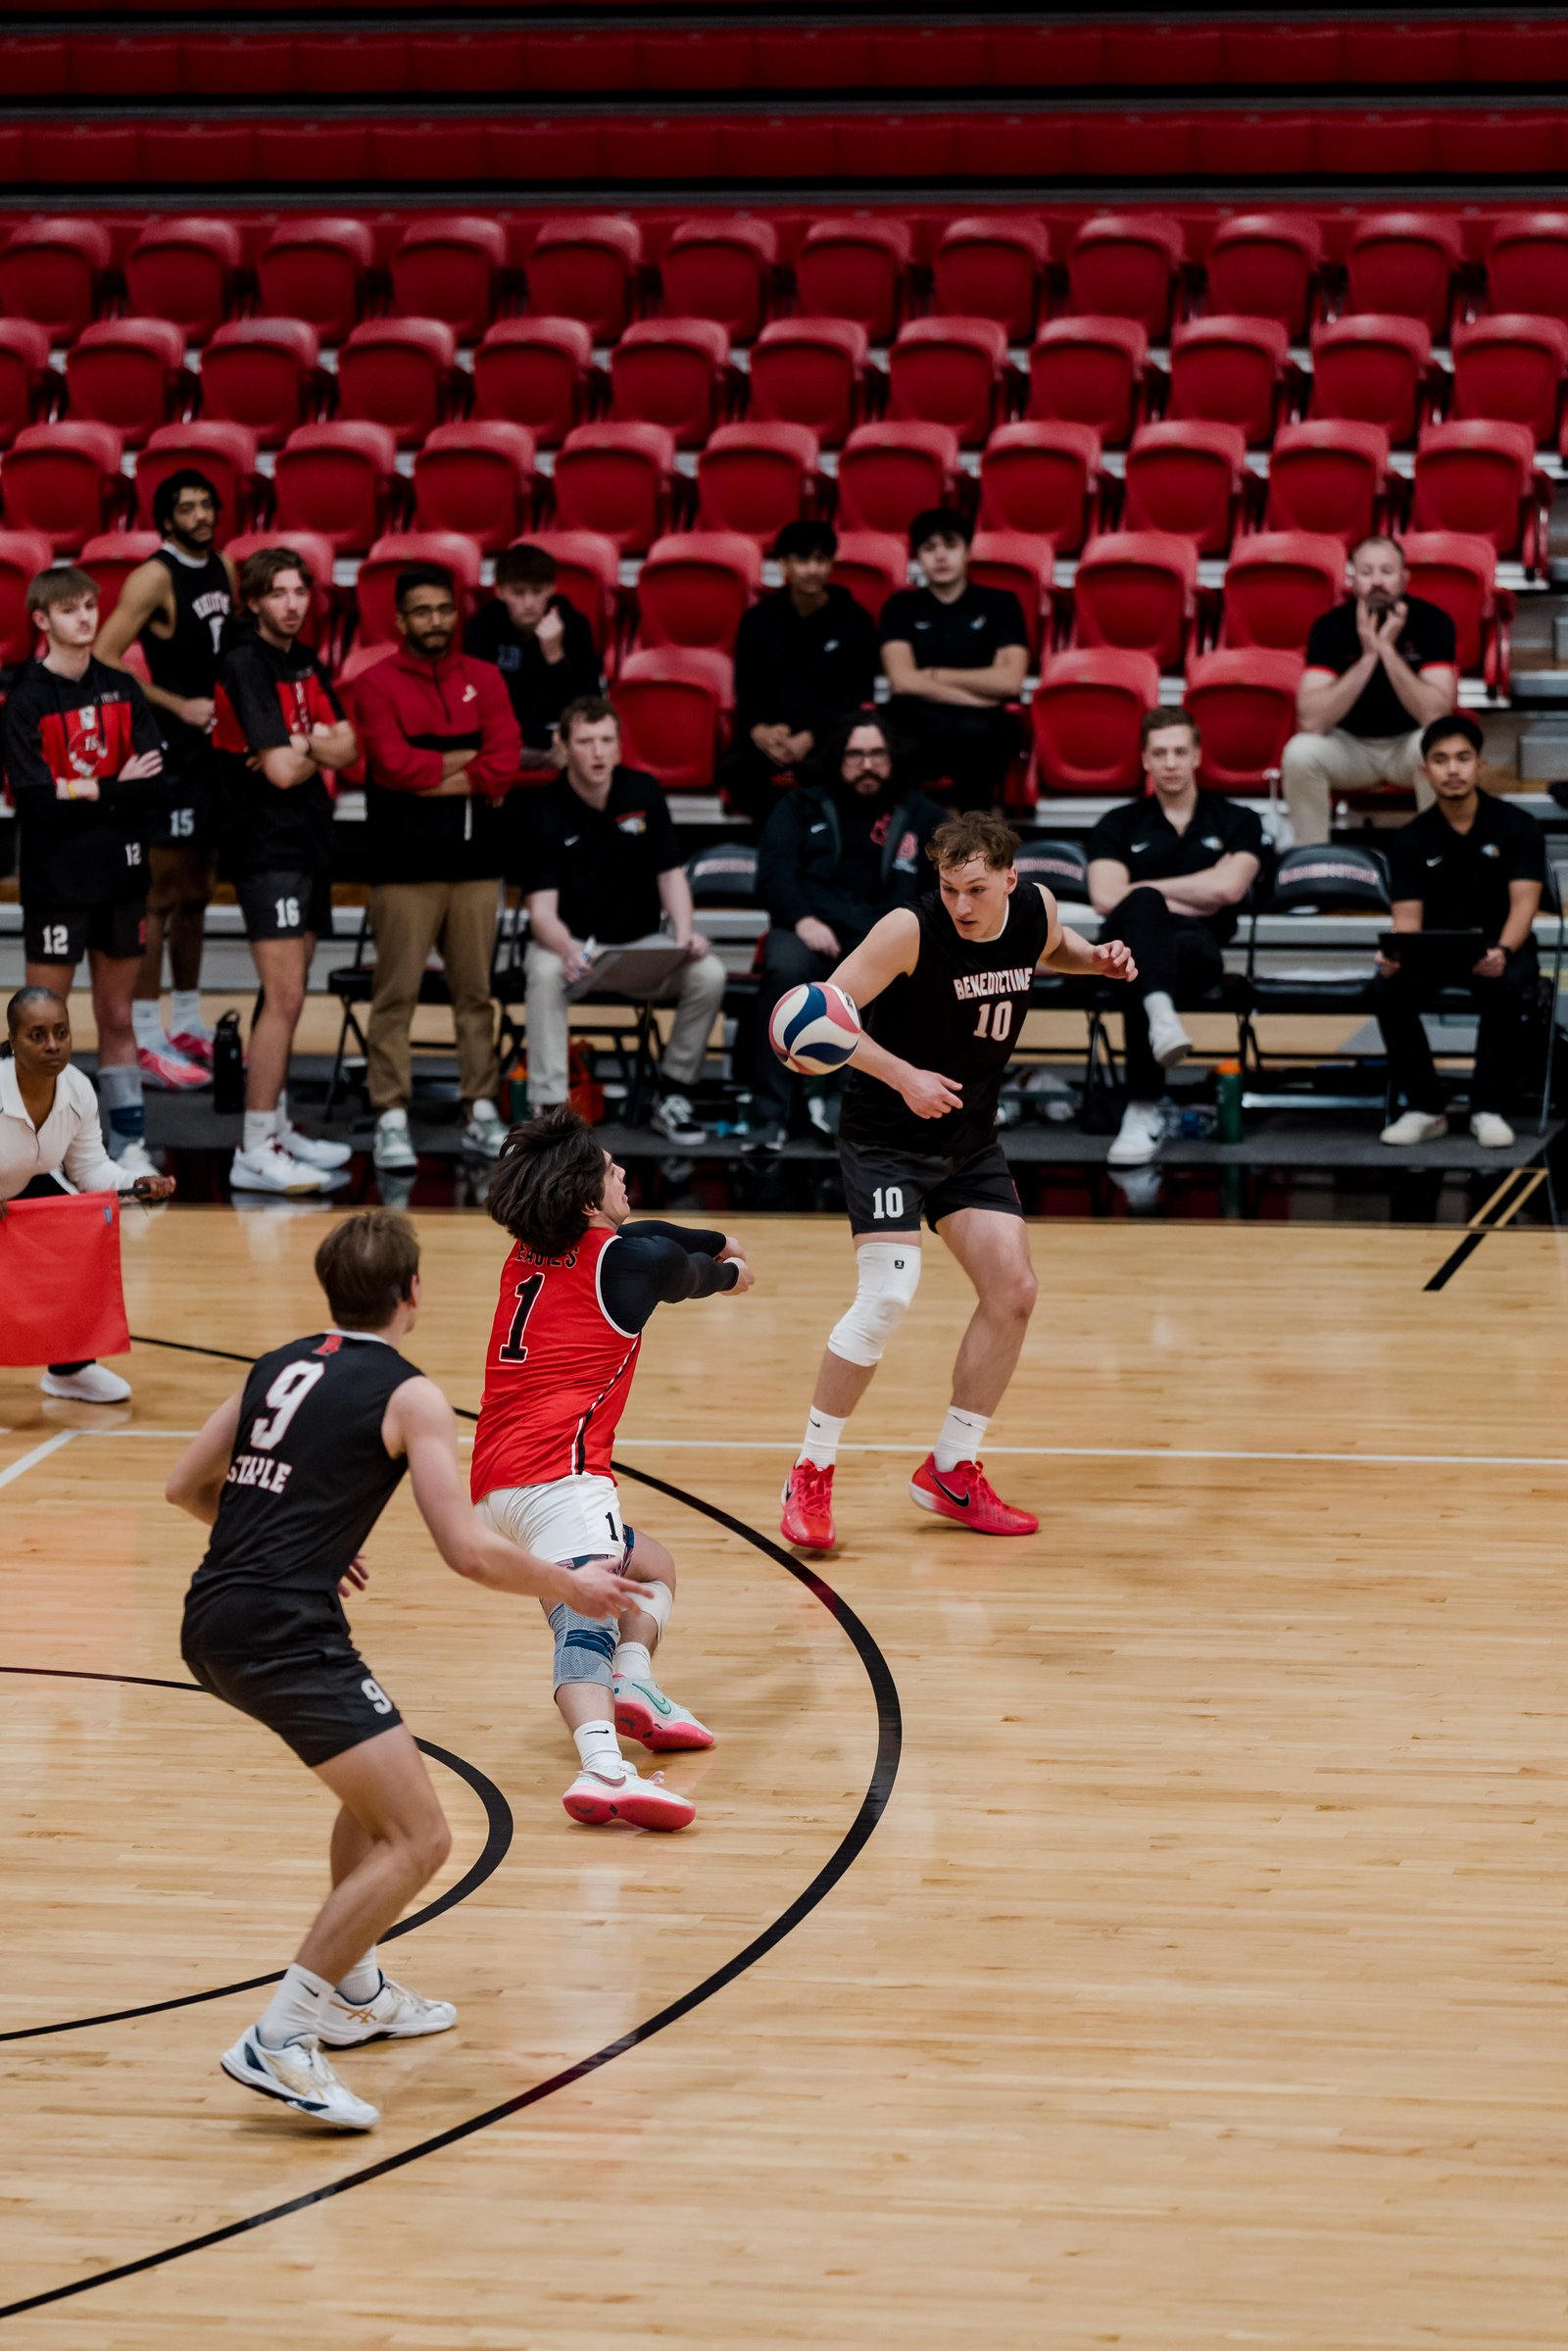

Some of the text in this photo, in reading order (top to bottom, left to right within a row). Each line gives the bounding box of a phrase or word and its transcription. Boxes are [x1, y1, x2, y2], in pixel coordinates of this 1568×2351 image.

[170, 808, 195, 837] 15
[124, 842, 142, 866] 12
[274, 896, 301, 928] 16
[42, 924, 70, 955] 12
[953, 967, 1034, 1001] BENEDICTINE
[973, 1000, 1013, 1042] 10
[872, 1187, 905, 1220] 10
[514, 1241, 580, 1269] EAS
[499, 1271, 546, 1363] 1
[250, 1359, 325, 1450] 9
[605, 1511, 619, 1543] 1
[361, 1677, 393, 1715] 9
